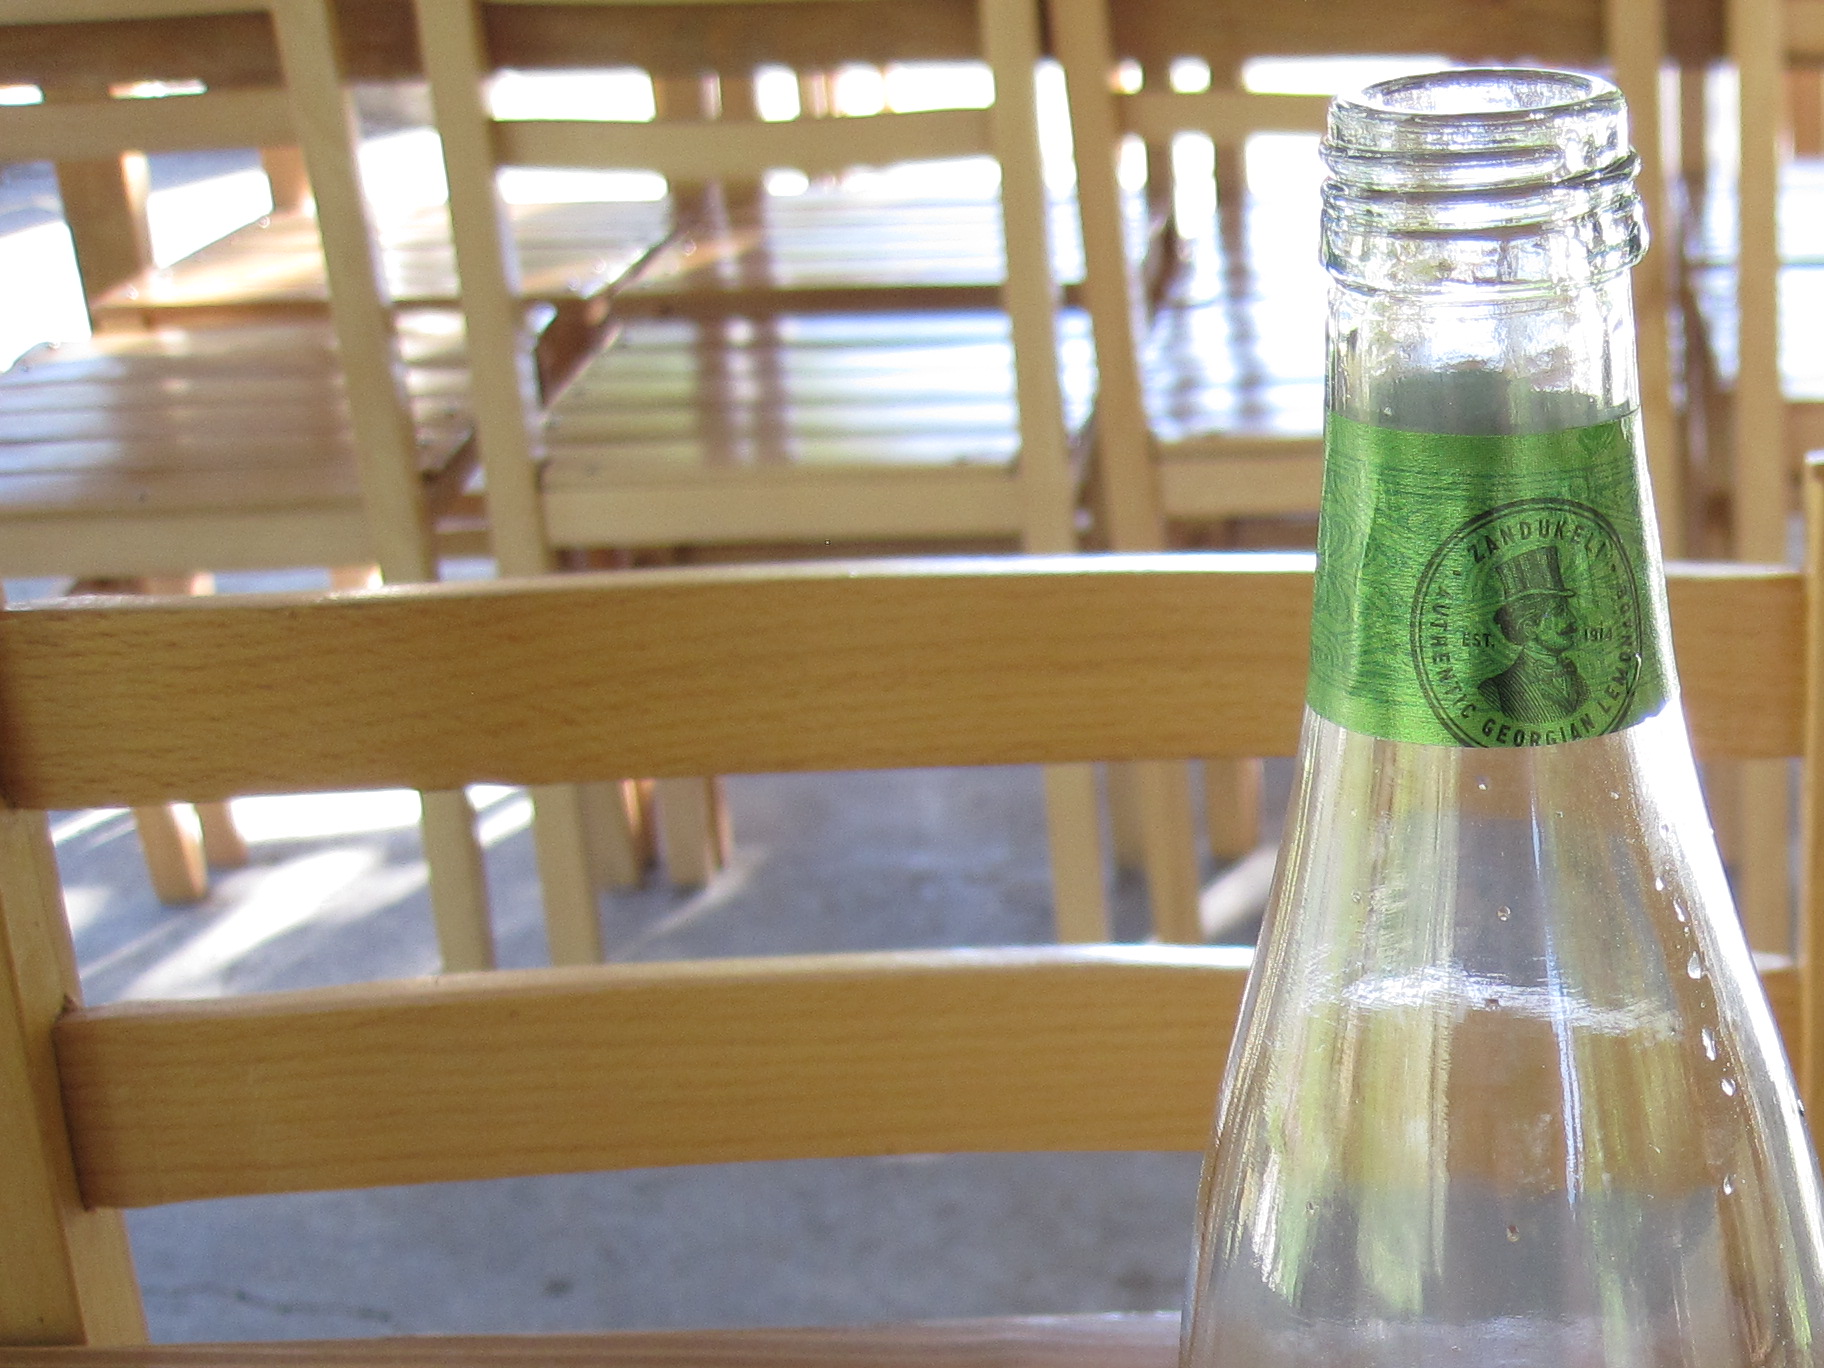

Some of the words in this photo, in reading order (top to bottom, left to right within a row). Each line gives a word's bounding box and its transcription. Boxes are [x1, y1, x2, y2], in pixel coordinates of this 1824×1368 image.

[1462, 633, 1495, 649] EST.
[1583, 627, 1613, 642] 1914
[1429, 585, 1477, 719] AUTHENTIC
[1482, 713, 1596, 747] GEORGIAN
